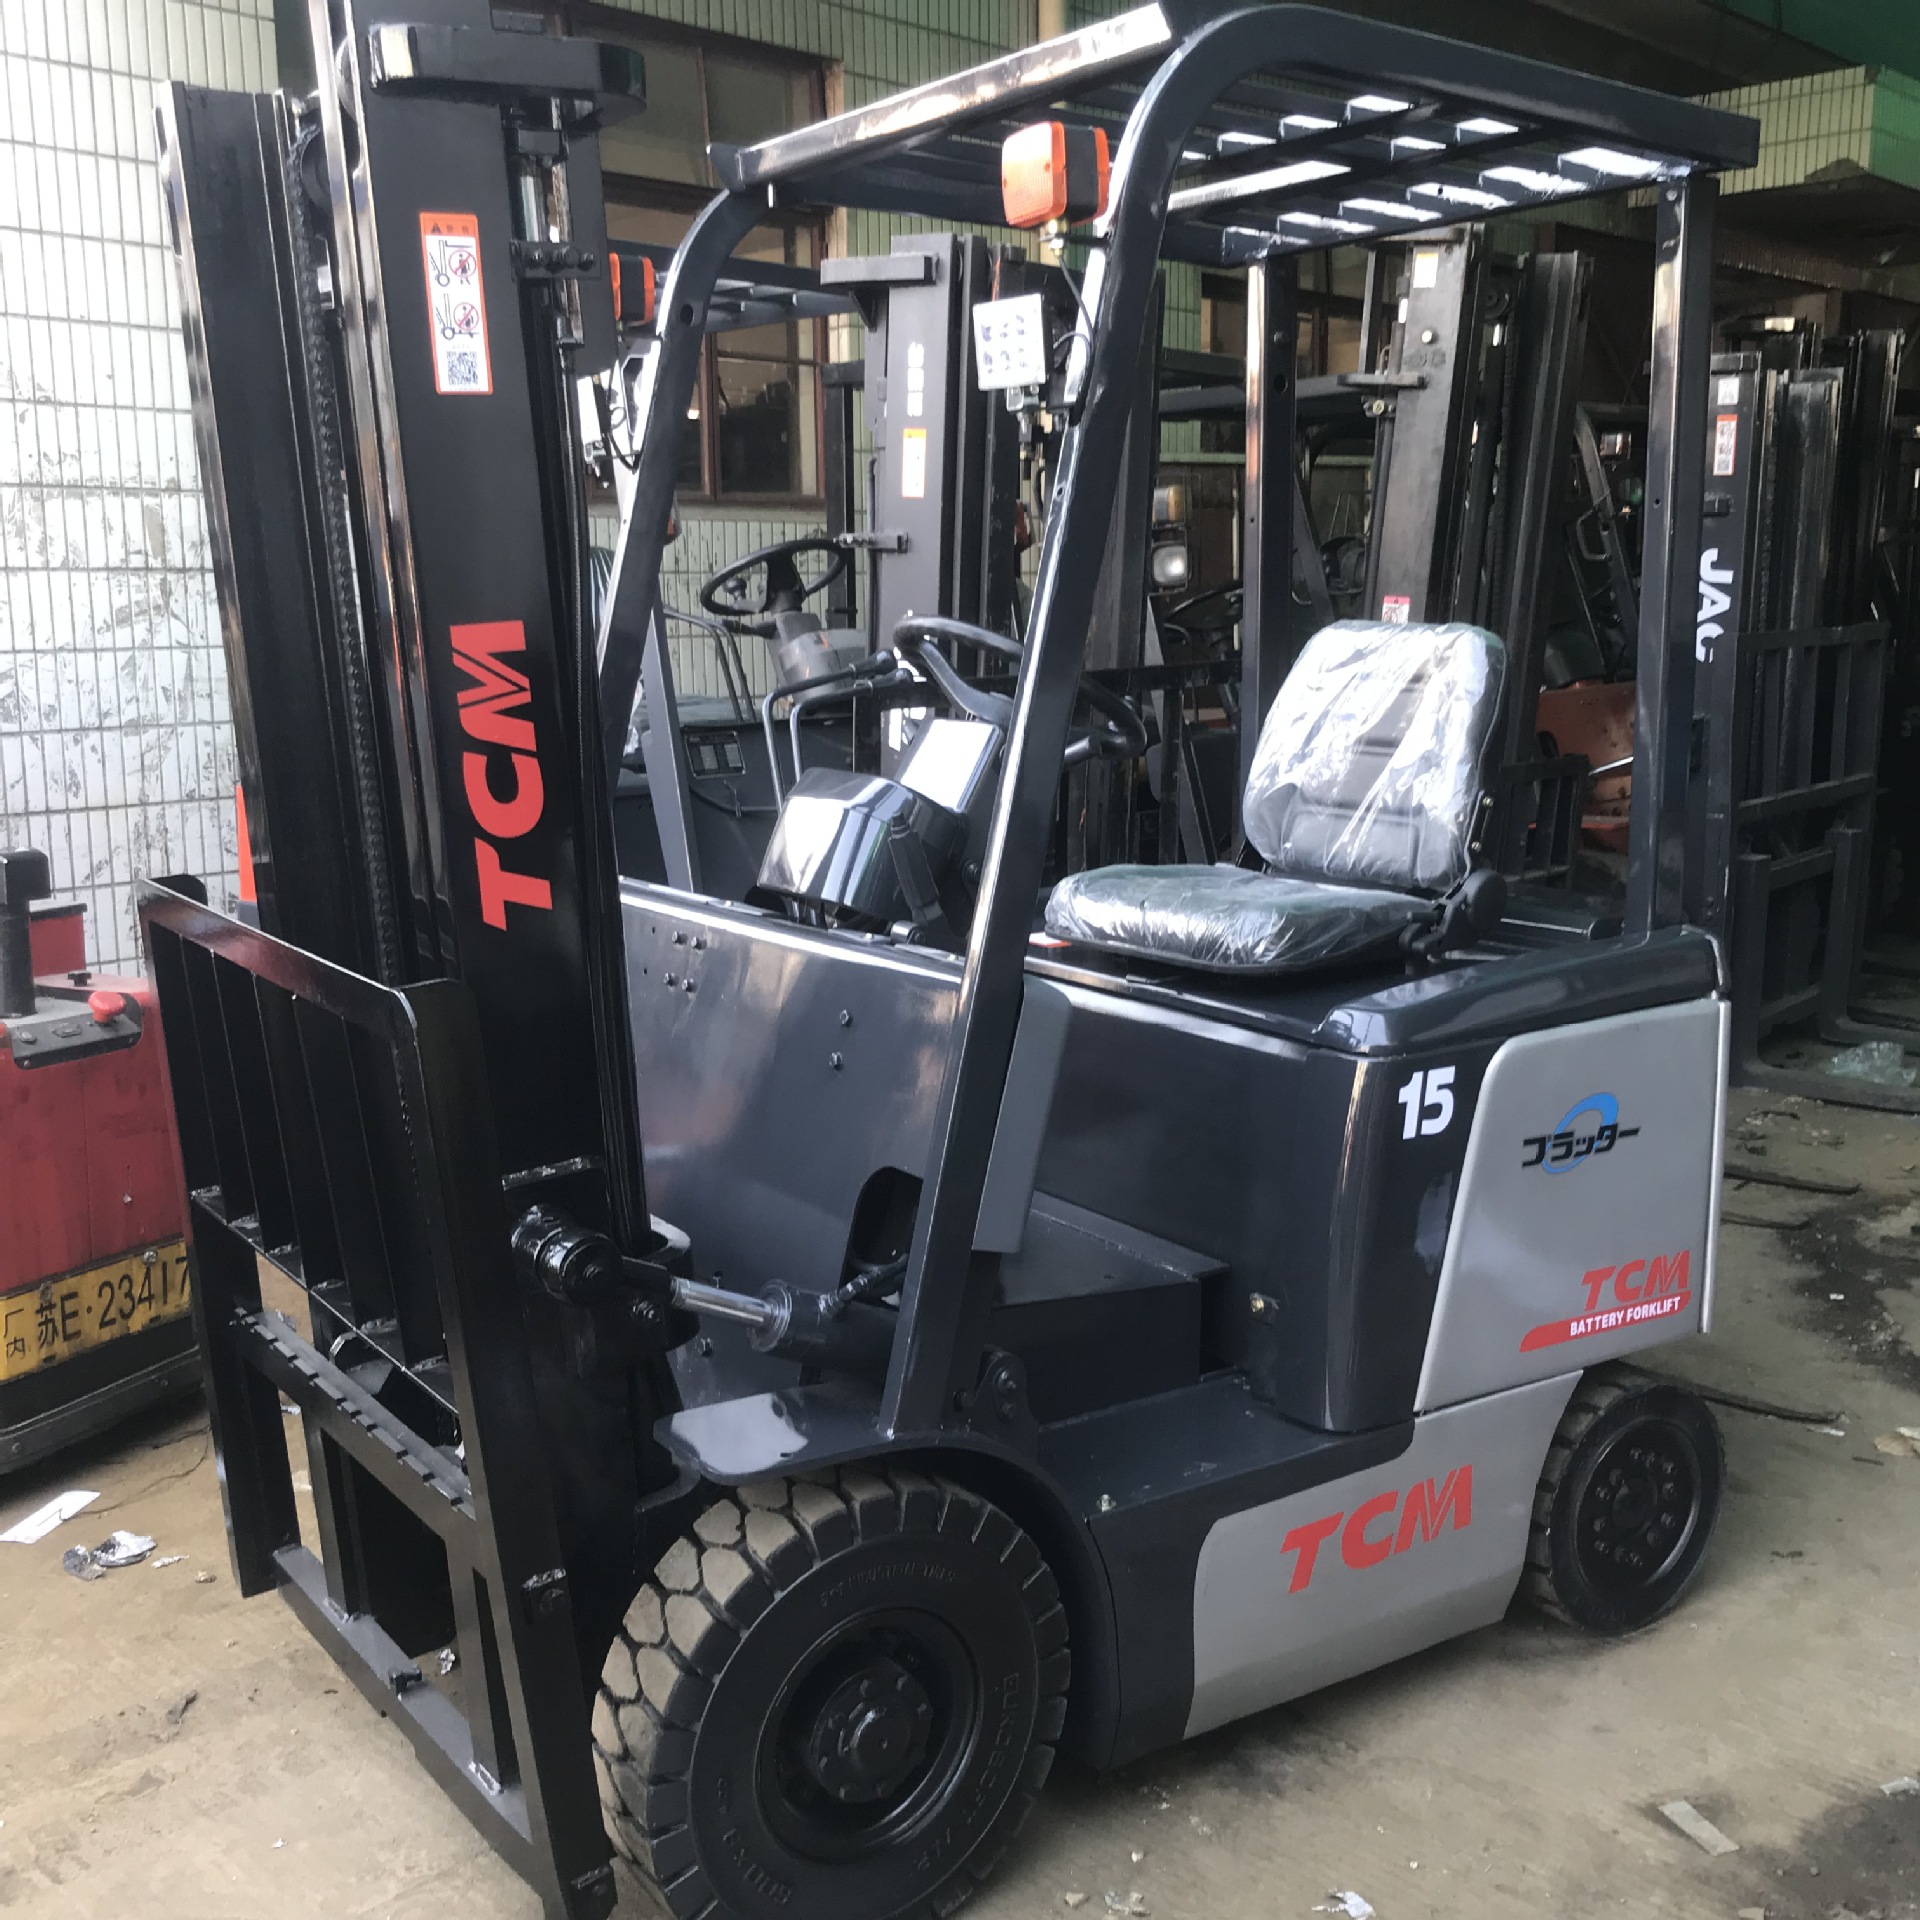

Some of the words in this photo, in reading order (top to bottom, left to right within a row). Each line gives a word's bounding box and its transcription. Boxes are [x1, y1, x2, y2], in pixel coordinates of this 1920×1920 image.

[450, 620, 552, 931] TCM
[1398, 1066, 1456, 1140] 15
[1570, 1310, 1624, 1336] BATTERY
[1626, 1296, 1681, 1323] FORKLIFT
[1581, 1250, 1690, 1312] TCM
[1280, 1464, 1473, 1595] TCM
